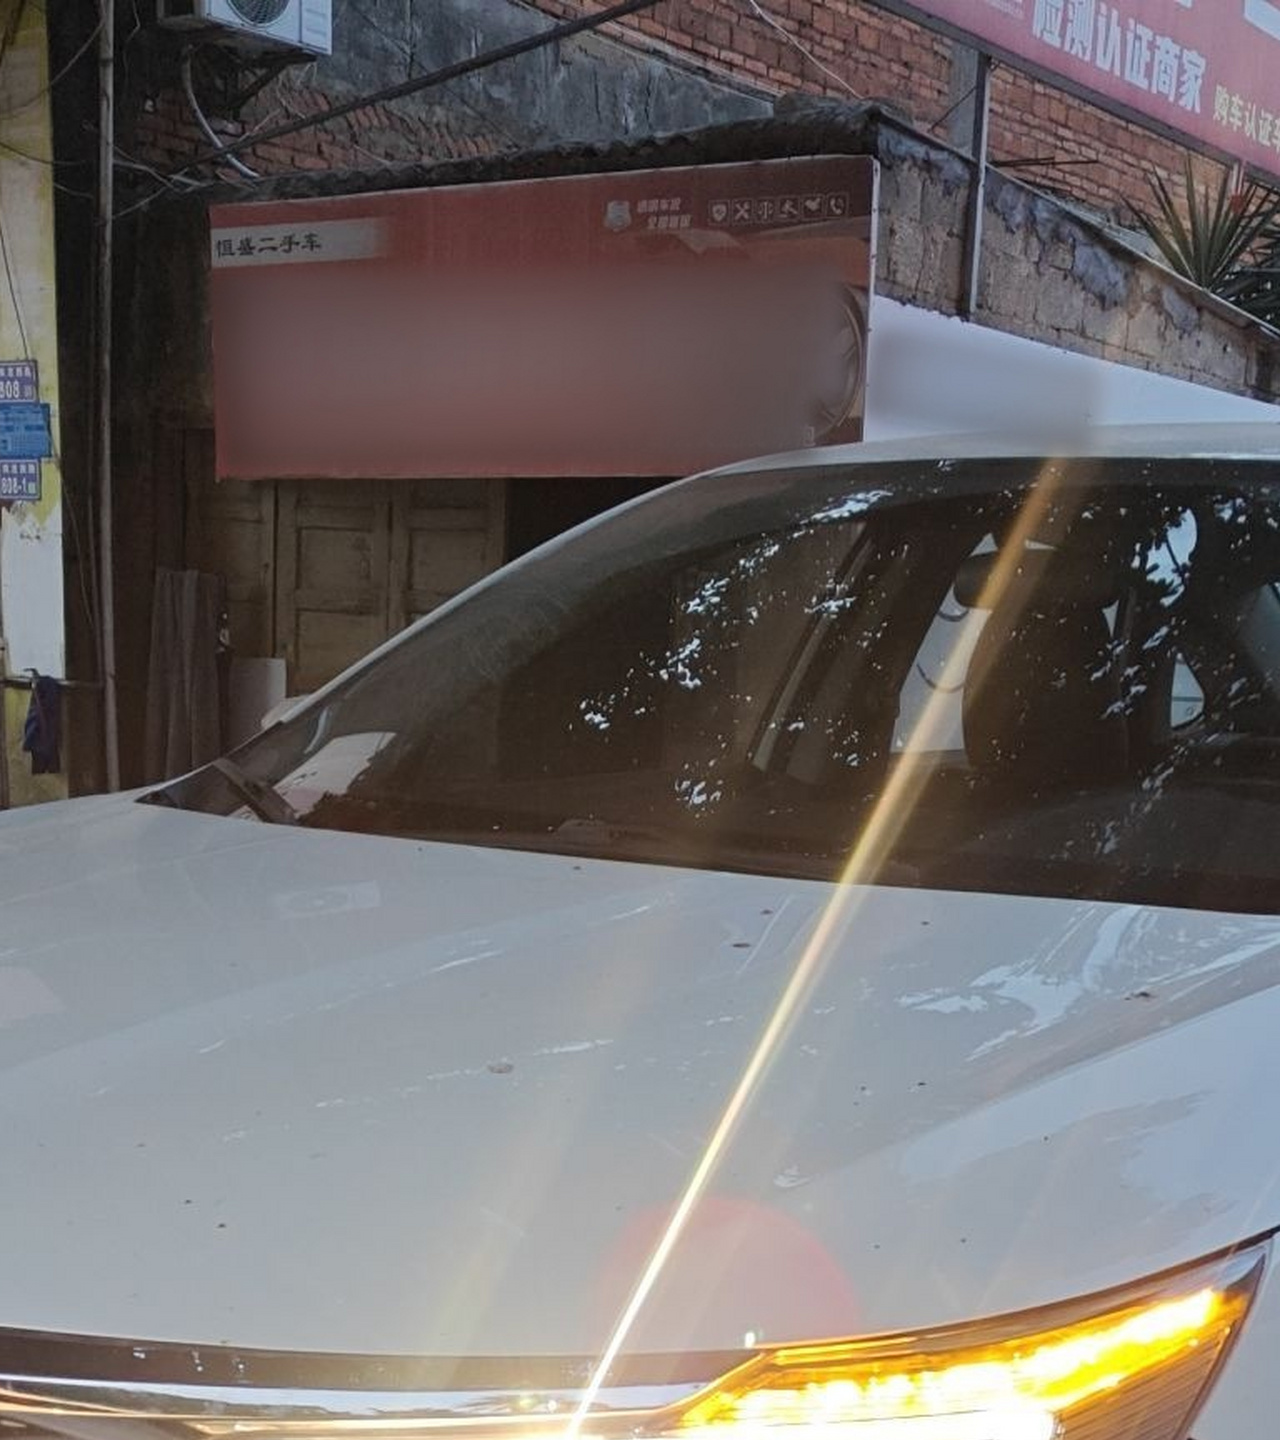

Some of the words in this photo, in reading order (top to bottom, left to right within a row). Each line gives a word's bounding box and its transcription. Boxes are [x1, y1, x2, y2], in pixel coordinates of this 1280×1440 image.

[216, 232, 322, 258] 恒盛二手车
